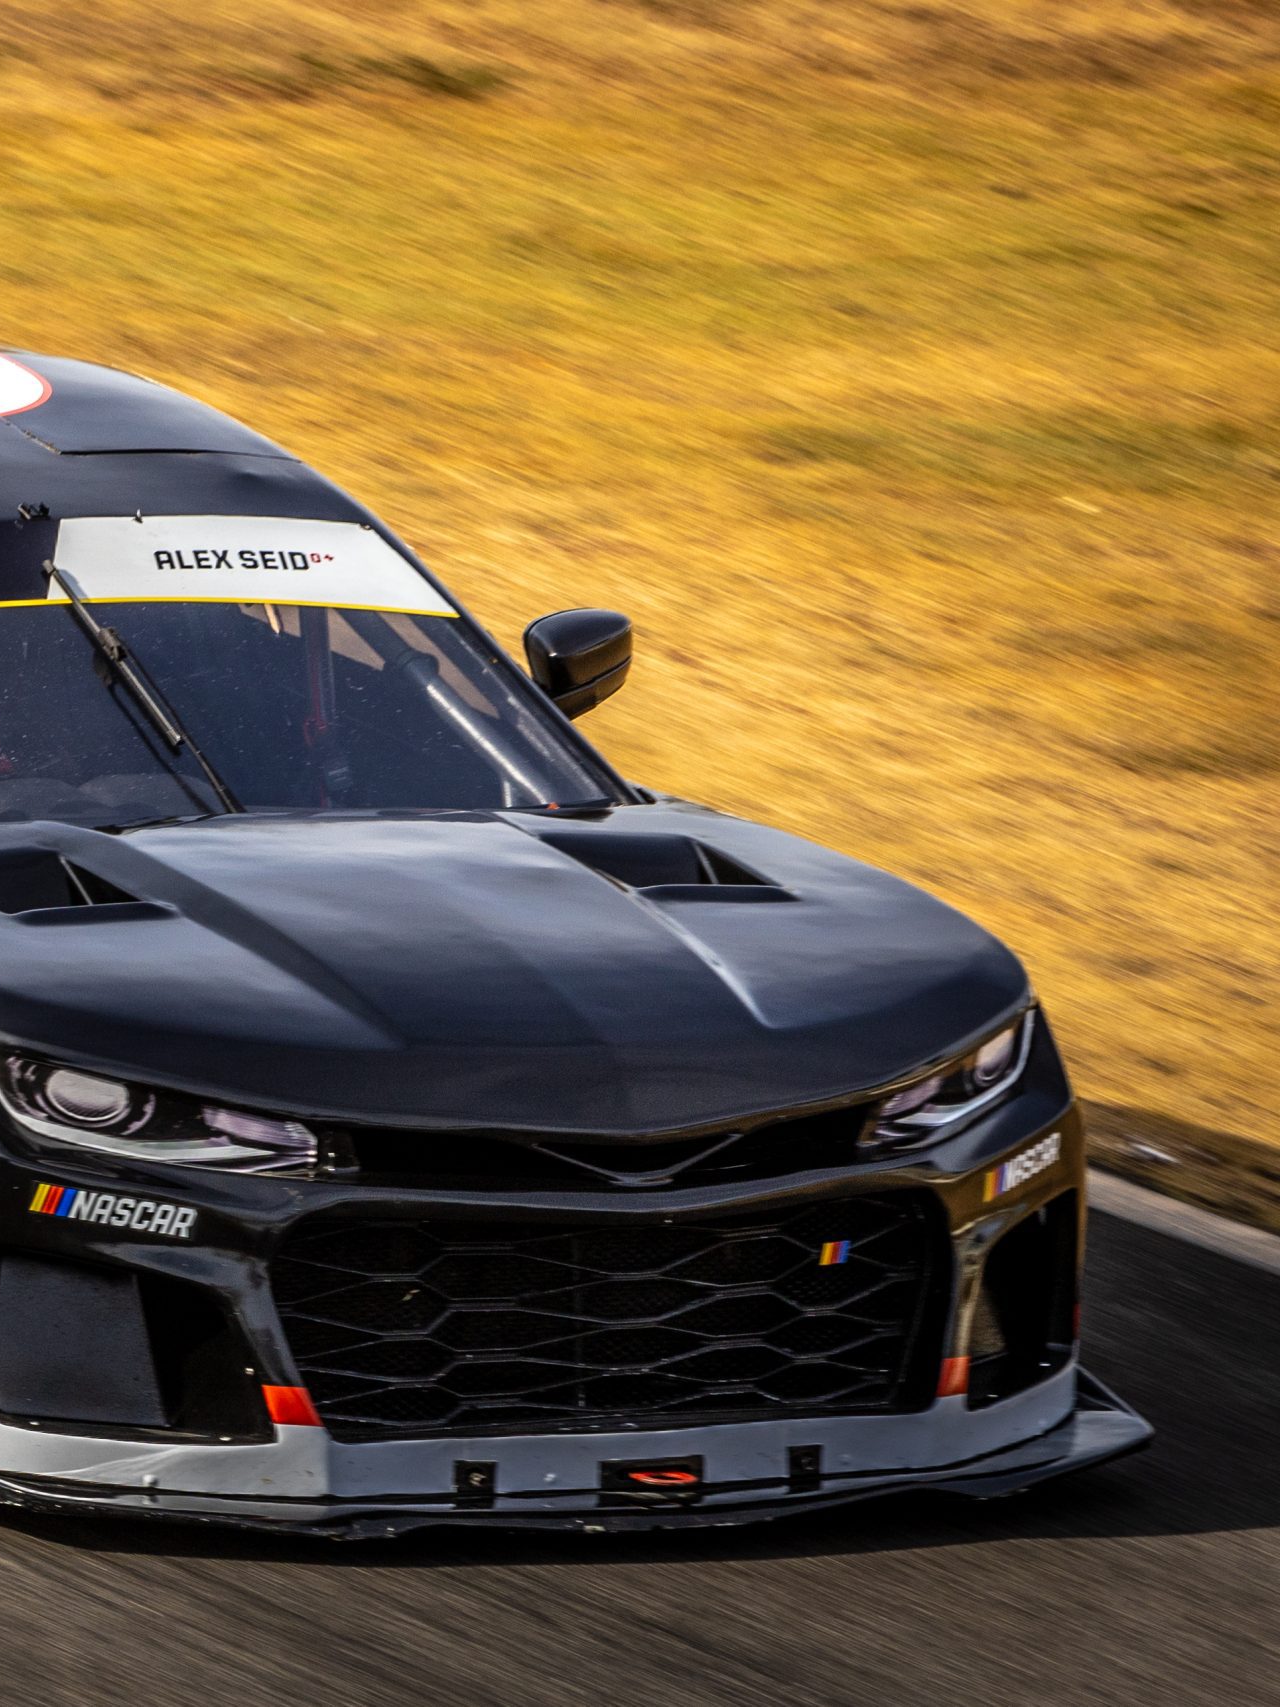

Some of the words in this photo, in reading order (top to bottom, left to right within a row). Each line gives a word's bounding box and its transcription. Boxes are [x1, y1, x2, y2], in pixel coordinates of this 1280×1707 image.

[153, 550, 234, 570] ALEX
[238, 550, 310, 571] SEID
[67, 1190, 198, 1238] NASCAR
